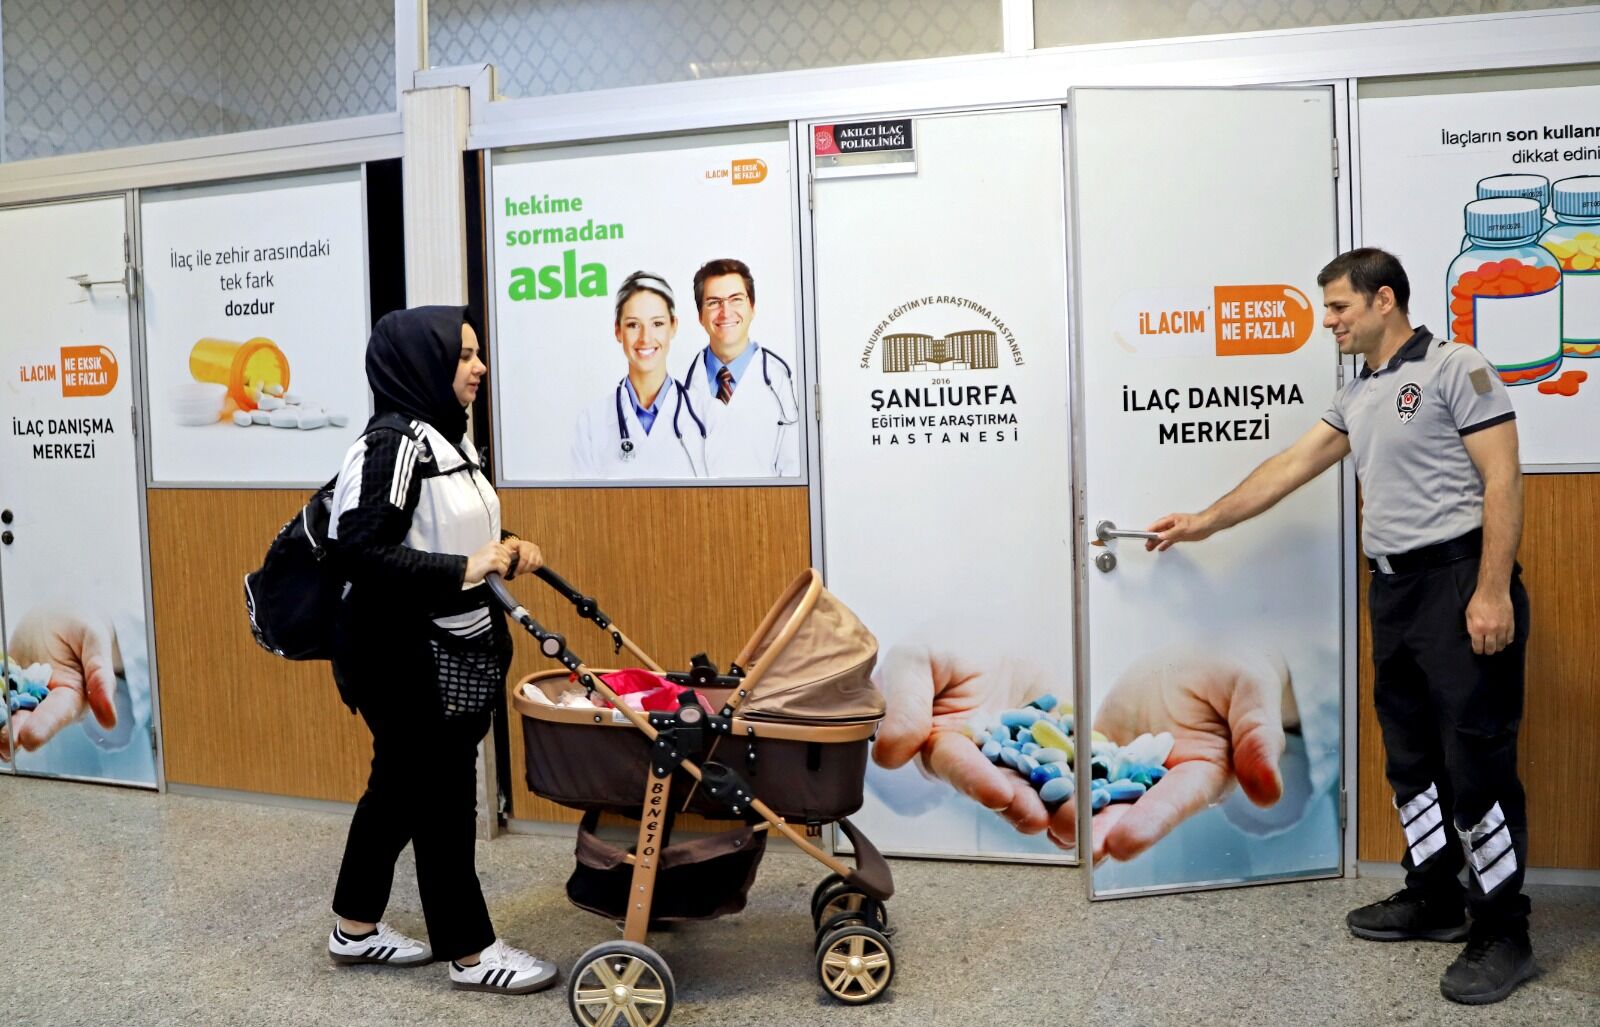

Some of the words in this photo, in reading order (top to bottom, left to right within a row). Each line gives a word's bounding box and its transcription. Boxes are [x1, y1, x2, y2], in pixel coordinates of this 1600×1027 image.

[841, 127, 876, 138] AKILCI
[878, 124, 903, 136] İLAÇ
[841, 134, 905, 149] POLİKLİNİĞİ
[1441, 128, 1501, 147] İlaçların
[1506, 129, 1538, 142] son
[1512, 148, 1559, 163] dikkat
[505, 193, 583, 217] hekime
[506, 219, 624, 246] sormadan
[171, 247, 193, 271] İlaç
[196, 249, 212, 266] ile
[215, 246, 250, 265] zehir
[253, 238, 330, 262] arasındaki
[220, 272, 242, 291] tek
[246, 270, 274, 289] fark
[508, 248, 608, 301] asla
[225, 298, 275, 316] dozdur
[1221, 301, 1240, 320] NE
[860, 320, 890, 370] ŞANLIURFA
[888, 299, 921, 323] EĞİTİM
[921, 295, 934, 306] VE
[936, 295, 992, 319] ARAŞTIRMA
[991, 315, 1026, 367] HASTANESİ
[1222, 322, 1241, 341] NE
[1245, 320, 1295, 340] FAZLA!
[64, 357, 76, 371] NE
[65, 373, 77, 387] NE
[78, 371, 108, 386] FAZLA!
[871, 384, 1017, 412] ŞANLIURFA
[1122, 385, 1180, 413] İLAÇ
[1188, 383, 1304, 410] DANIŞMA
[13, 416, 44, 437] İLAÇ
[48, 418, 114, 436] DANIŞMA
[871, 413, 916, 429] EĞİTİM
[920, 416, 936, 427] VE
[939, 413, 1018, 427] ARAŞTIRMA
[1159, 413, 1270, 444] MERKEZİ
[33, 439, 95, 459] MERKEZİ
[642, 783, 664, 856] BENETO
